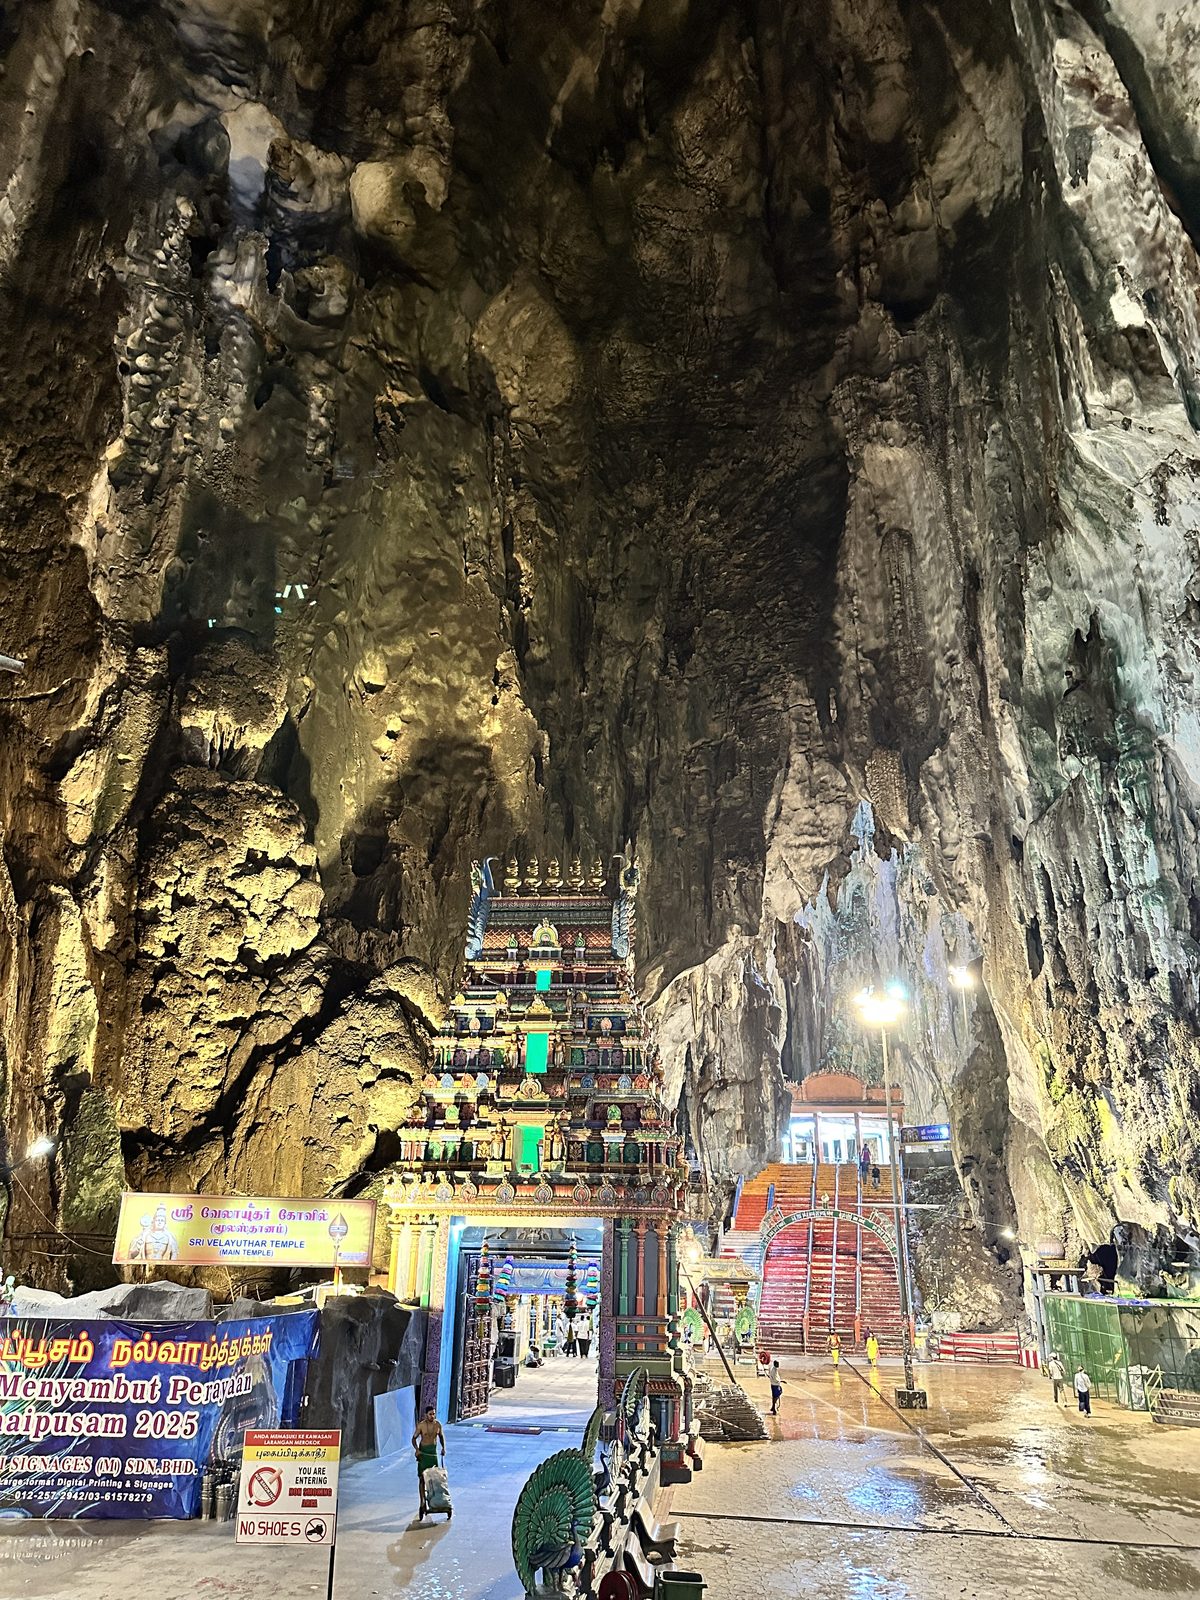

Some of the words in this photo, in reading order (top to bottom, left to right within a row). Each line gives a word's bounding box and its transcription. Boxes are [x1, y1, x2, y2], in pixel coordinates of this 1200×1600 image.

[278, 1208, 328, 1221] கோவில்
[210, 1222, 288, 1236] (மூலஸ்தானம்)
[189, 1238, 205, 1246] SRI
[207, 1238, 267, 1248] VELAYUTHAR
[270, 1240, 305, 1248] TEMPLE
[219, 1249, 241, 1257] (MAIN
[243, 1249, 274, 1258] TEMPLE)
[0, 1329, 95, 1369] ப்பூசம்
[108, 1326, 272, 1372] நல்வாழ்த்துக்கள்
[0, 1373, 161, 1407] Menyambut
[167, 1372, 253, 1406] Perayaan
[0, 1406, 127, 1441] aipusam
[133, 1410, 199, 1439] 2025
[9, 1455, 93, 1474] SIGNAGES
[95, 1457, 121, 1477] (M)
[124, 1458, 198, 1475] SDN.BHD.
[298, 1467, 312, 1475] YOU
[312, 1467, 326, 1475] ARE
[57, 1478, 86, 1487] Digital
[89, 1479, 122, 1489] Printing
[125, 1480, 131, 1488] &
[133, 1480, 174, 1490] Signages
[295, 1476, 328, 1485] ENTERING
[14, 1490, 57, 1500] 012-257
[60, 1490, 153, 1502] 2942/03-61578279
[239, 1521, 255, 1536] NO
[257, 1521, 301, 1536] SHOES
